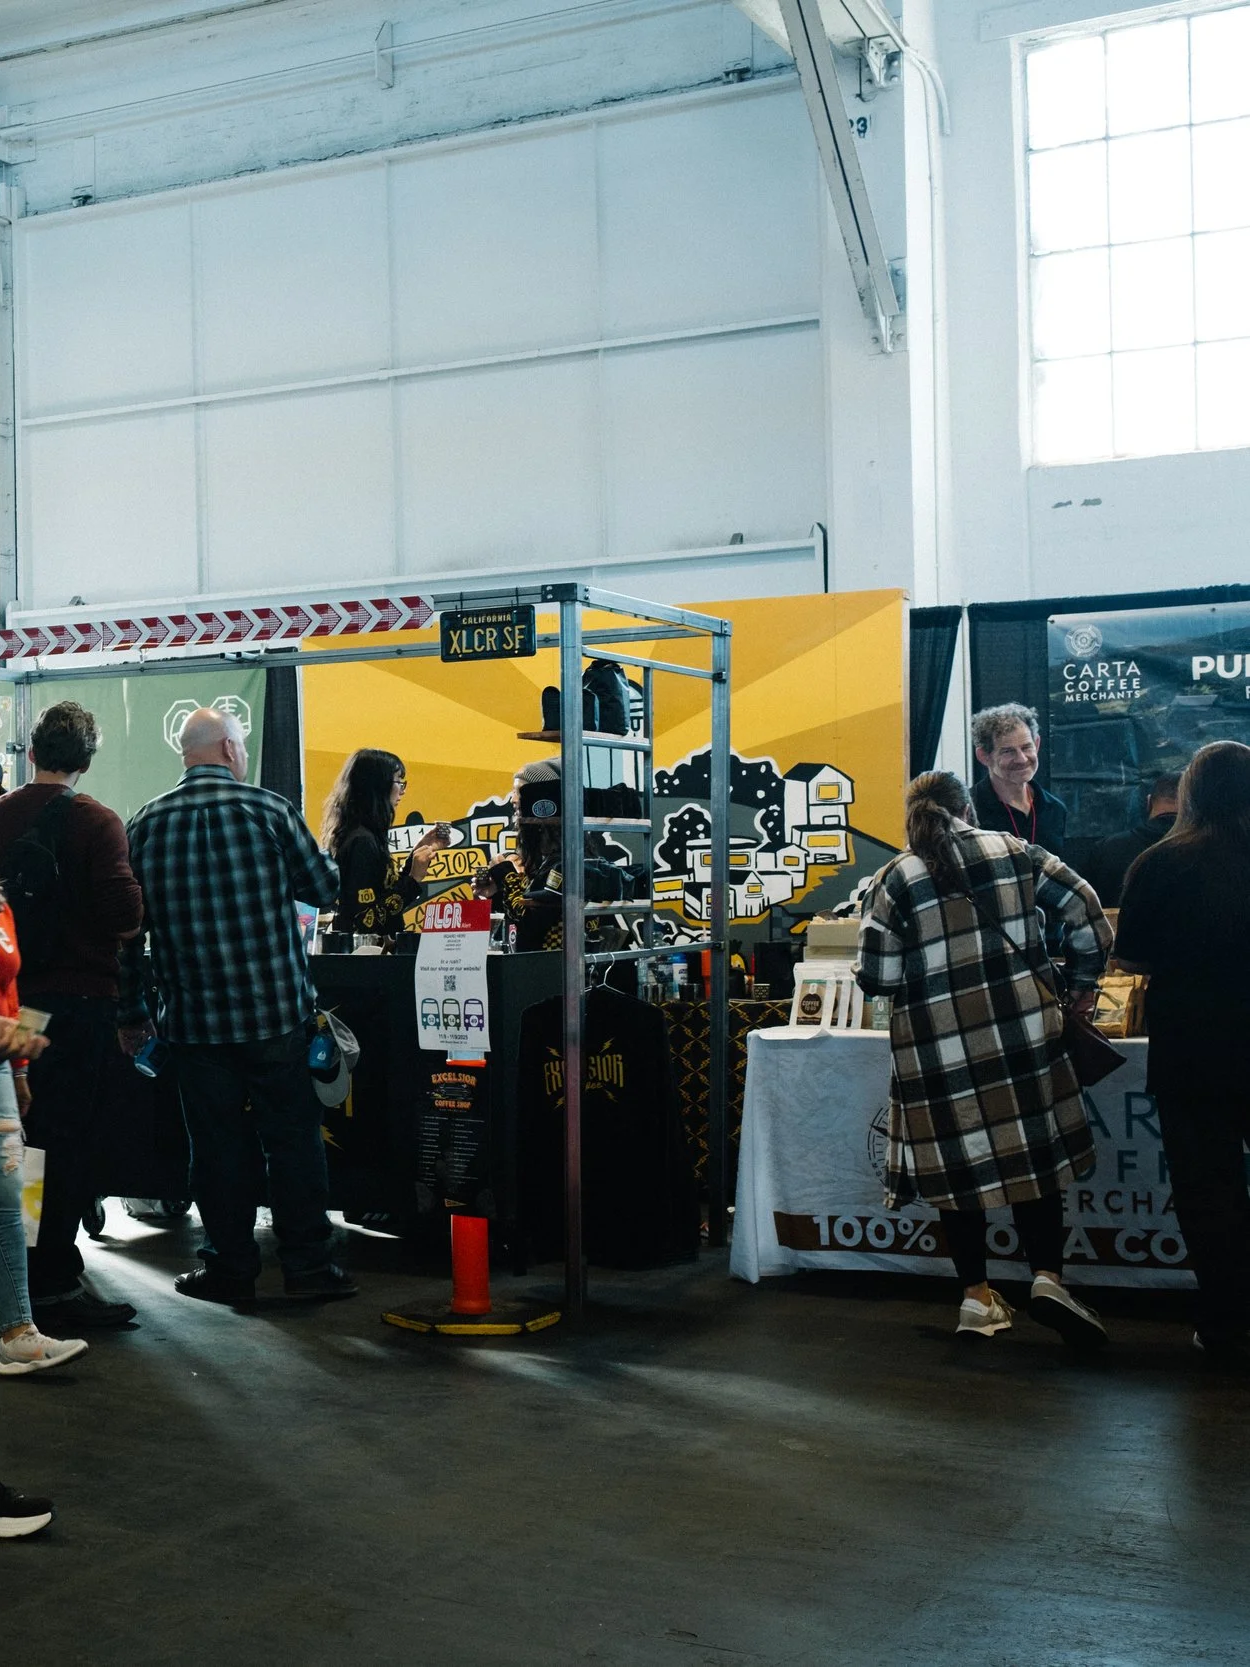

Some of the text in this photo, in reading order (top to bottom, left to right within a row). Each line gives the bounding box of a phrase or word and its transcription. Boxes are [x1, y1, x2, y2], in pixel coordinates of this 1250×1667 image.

[462, 613, 512, 625] CALIFORNIA
[449, 624, 527, 655] XLCR SF
[1063, 660, 1141, 680] CARTA
[1192, 653, 1250, 680] PU
[1064, 678, 1141, 693] COFFEE
[1065, 690, 1141, 703] MERCHANTS
[423, 902, 463, 930] XLCR
[431, 1072, 478, 1087] EXCELSIOR
[434, 1099, 456, 1109] COFFEE
[812, 1214, 937, 1252] 100%
